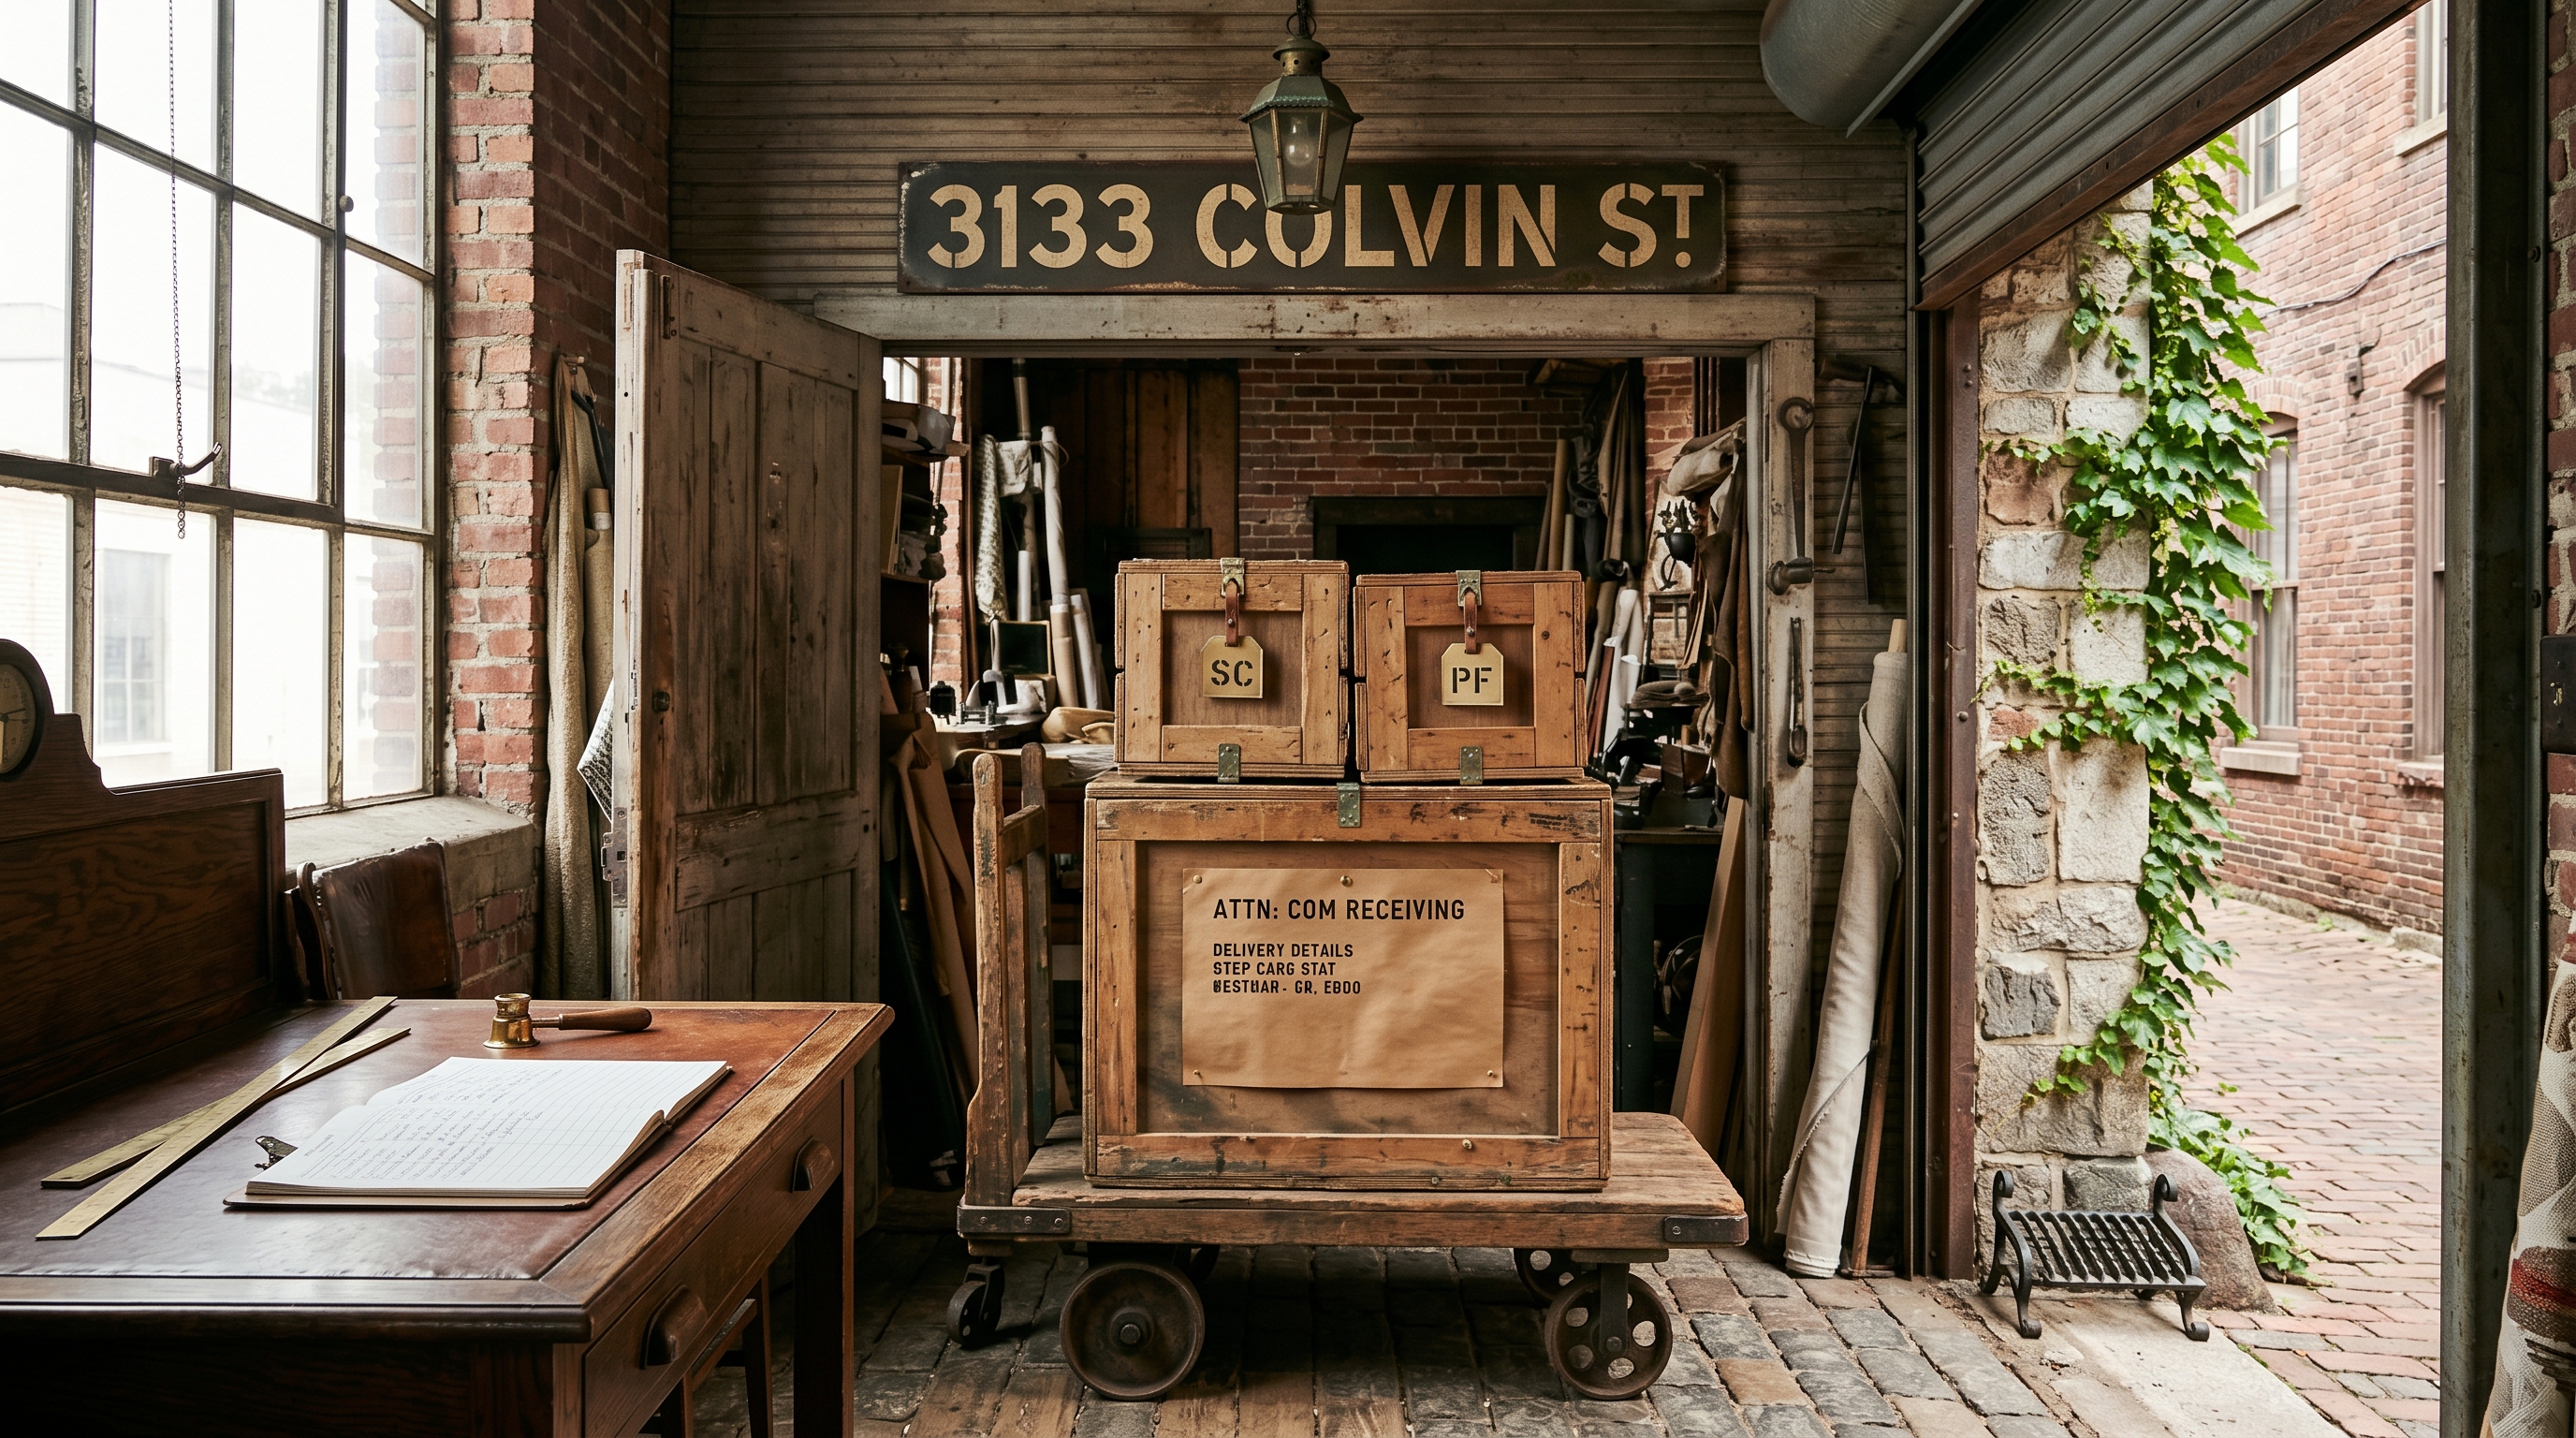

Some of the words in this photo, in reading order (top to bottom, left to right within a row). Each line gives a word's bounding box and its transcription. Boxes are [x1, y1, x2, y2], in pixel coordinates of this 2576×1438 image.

[928, 183, 1153, 269] 3133
[1195, 183, 1556, 269] COLVIN
[1210, 659, 1253, 687] SC
[1452, 667, 1492, 694] PF
[1213, 899, 1279, 919] ATTN:
[1288, 899, 1336, 920] COM
[1346, 899, 1464, 920] RECEIVING
[1213, 943, 1285, 958] DELIVERY
[1291, 943, 1354, 958] DETAILS
[1213, 961, 1251, 976] STEP
[1256, 961, 1295, 976] CARG
[1301, 961, 1337, 976] STAT
